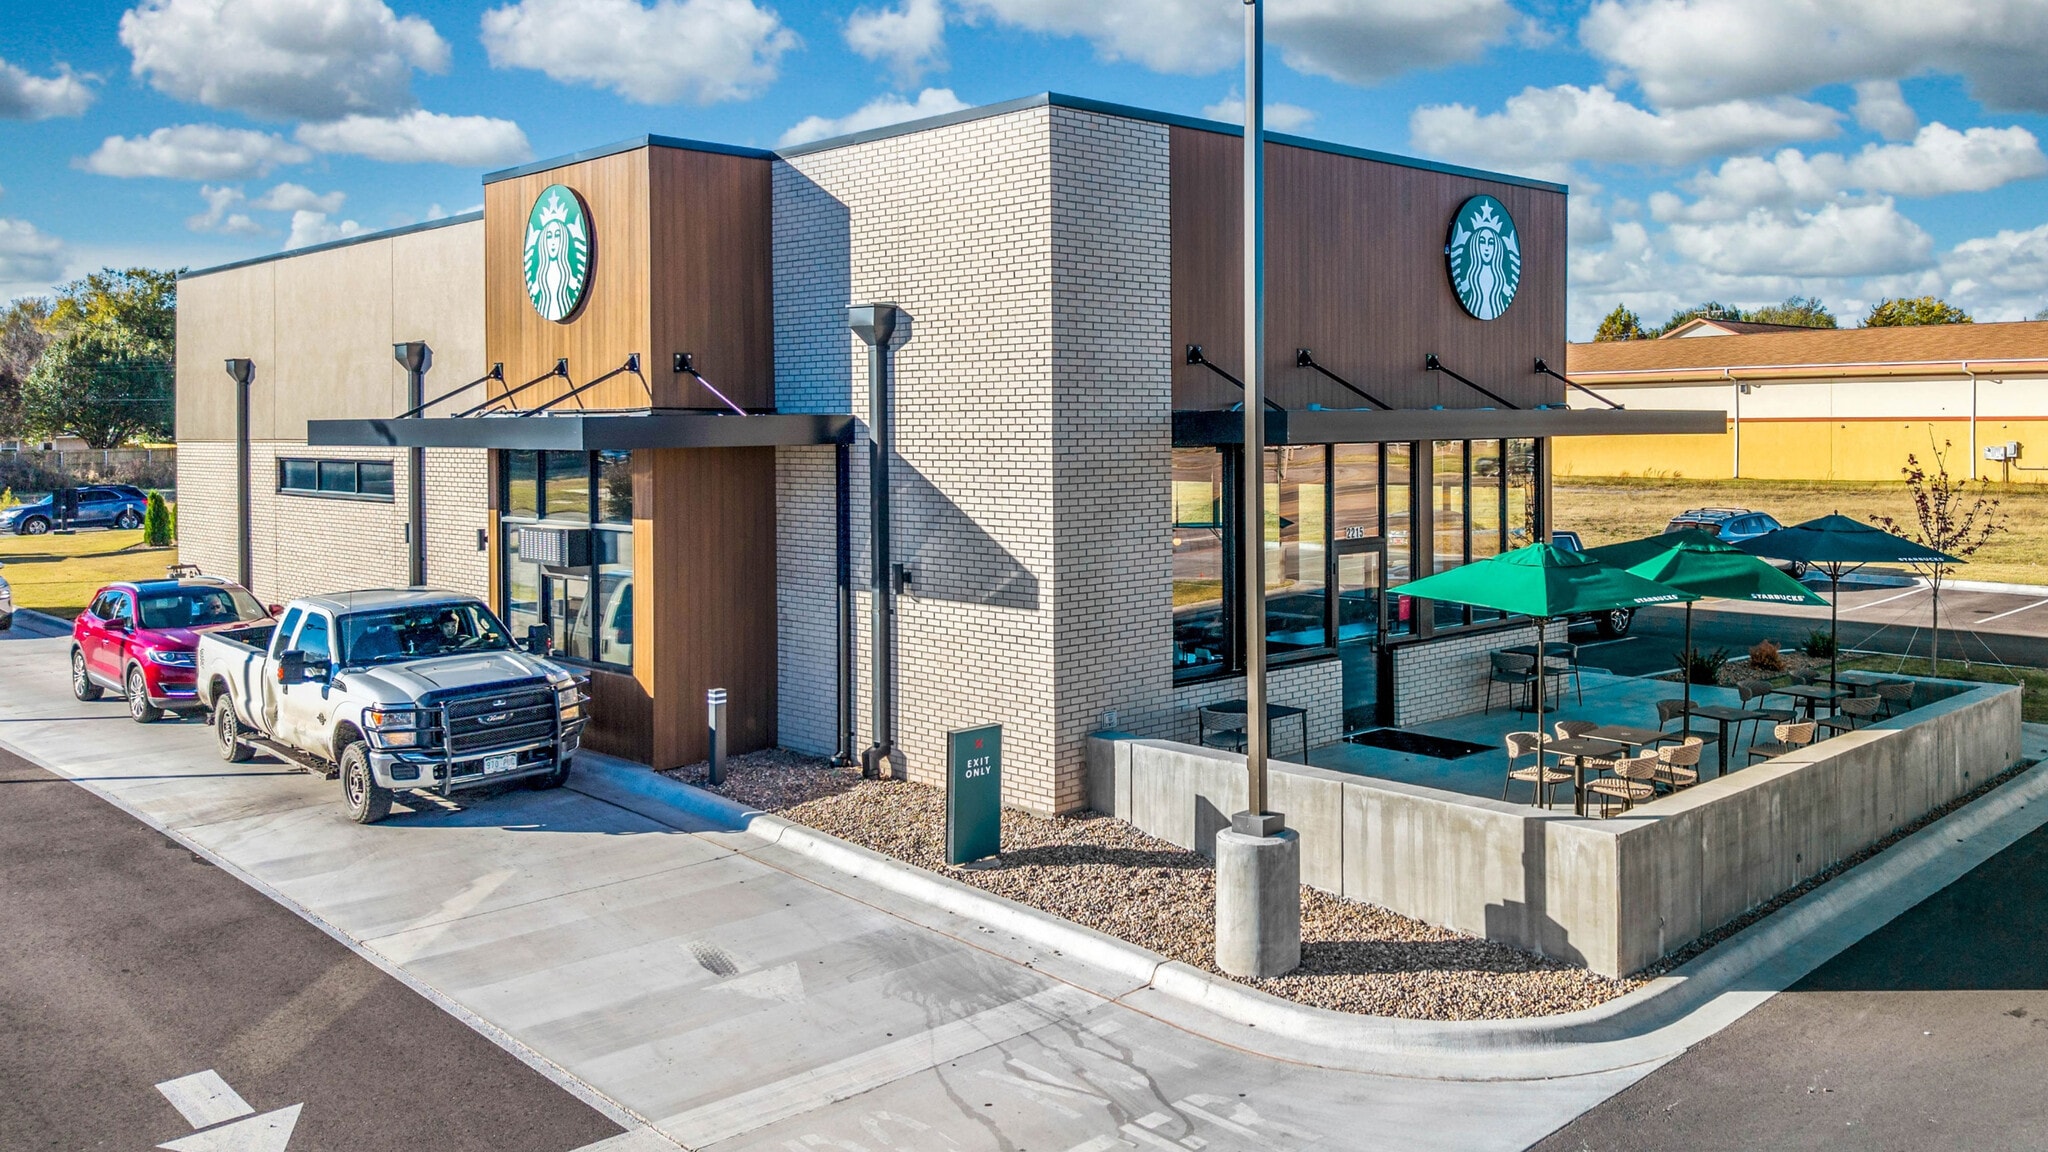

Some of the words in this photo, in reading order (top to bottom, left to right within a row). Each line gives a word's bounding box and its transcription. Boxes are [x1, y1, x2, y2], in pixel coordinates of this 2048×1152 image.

[1346, 526, 1364, 539] 2215
[1633, 594, 1679, 604] STARBUCKS
[1750, 593, 1804, 602] STARBUCKS
[967, 756, 990, 768] EXIT
[965, 765, 991, 779] ONLY
